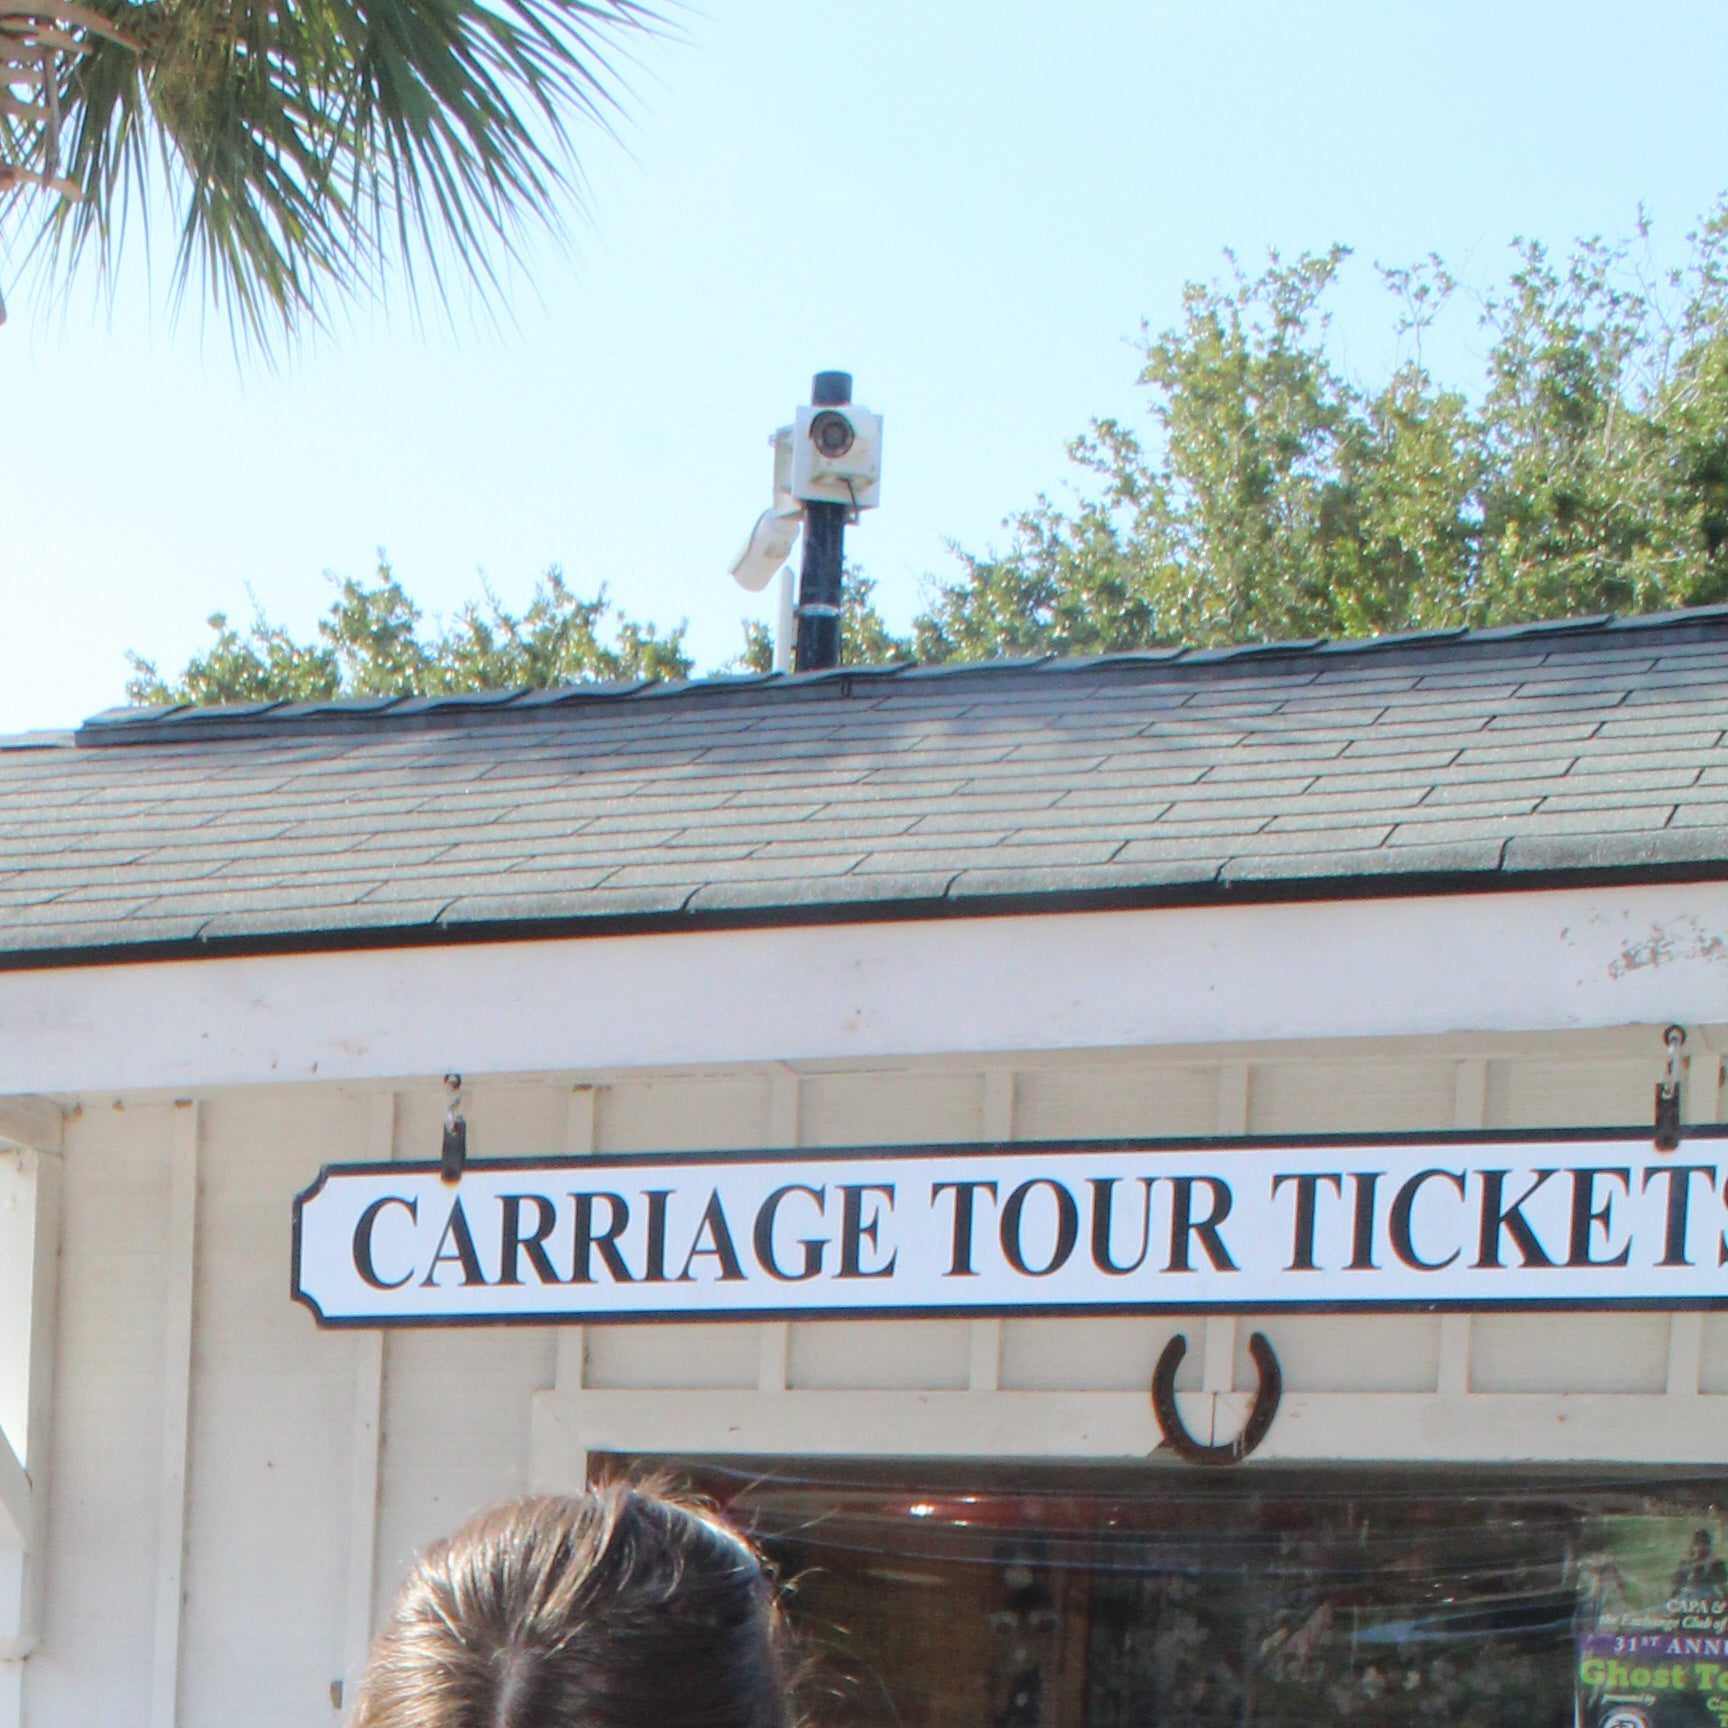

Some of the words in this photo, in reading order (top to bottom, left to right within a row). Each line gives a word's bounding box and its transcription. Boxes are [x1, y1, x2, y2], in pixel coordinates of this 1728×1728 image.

[352, 1182, 899, 1290] CARRIAGE
[930, 1174, 1242, 1278] TOUR
[1271, 1164, 1728, 1273] TICKET
[1666, 1636, 1728, 1656] ANN
[1579, 1657, 1685, 1690] Ghost
